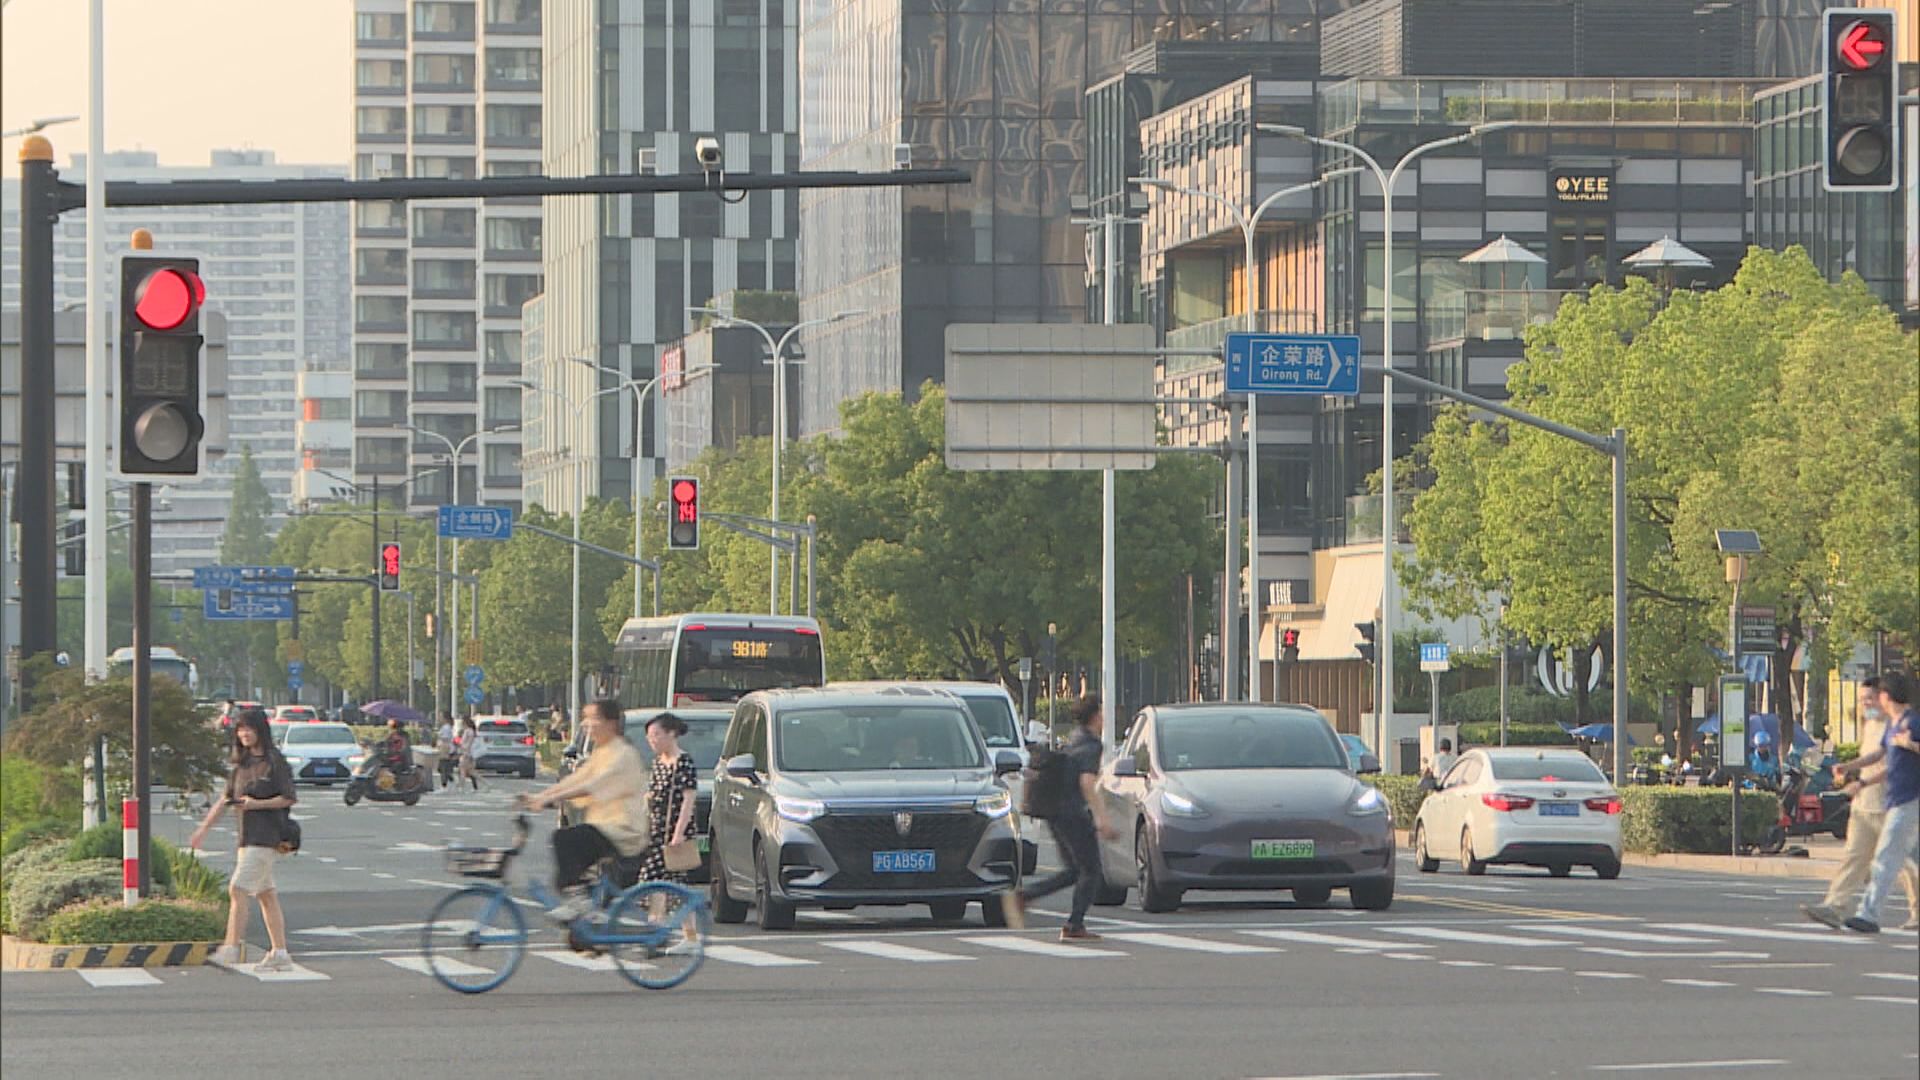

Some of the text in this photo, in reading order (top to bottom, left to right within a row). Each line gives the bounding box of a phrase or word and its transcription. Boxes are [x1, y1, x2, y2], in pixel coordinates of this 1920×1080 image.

[1261, 344, 1325, 367] 企荣路
[1261, 368, 1324, 384] Qirong Rd.
[732, 639, 769, 659] 981路
